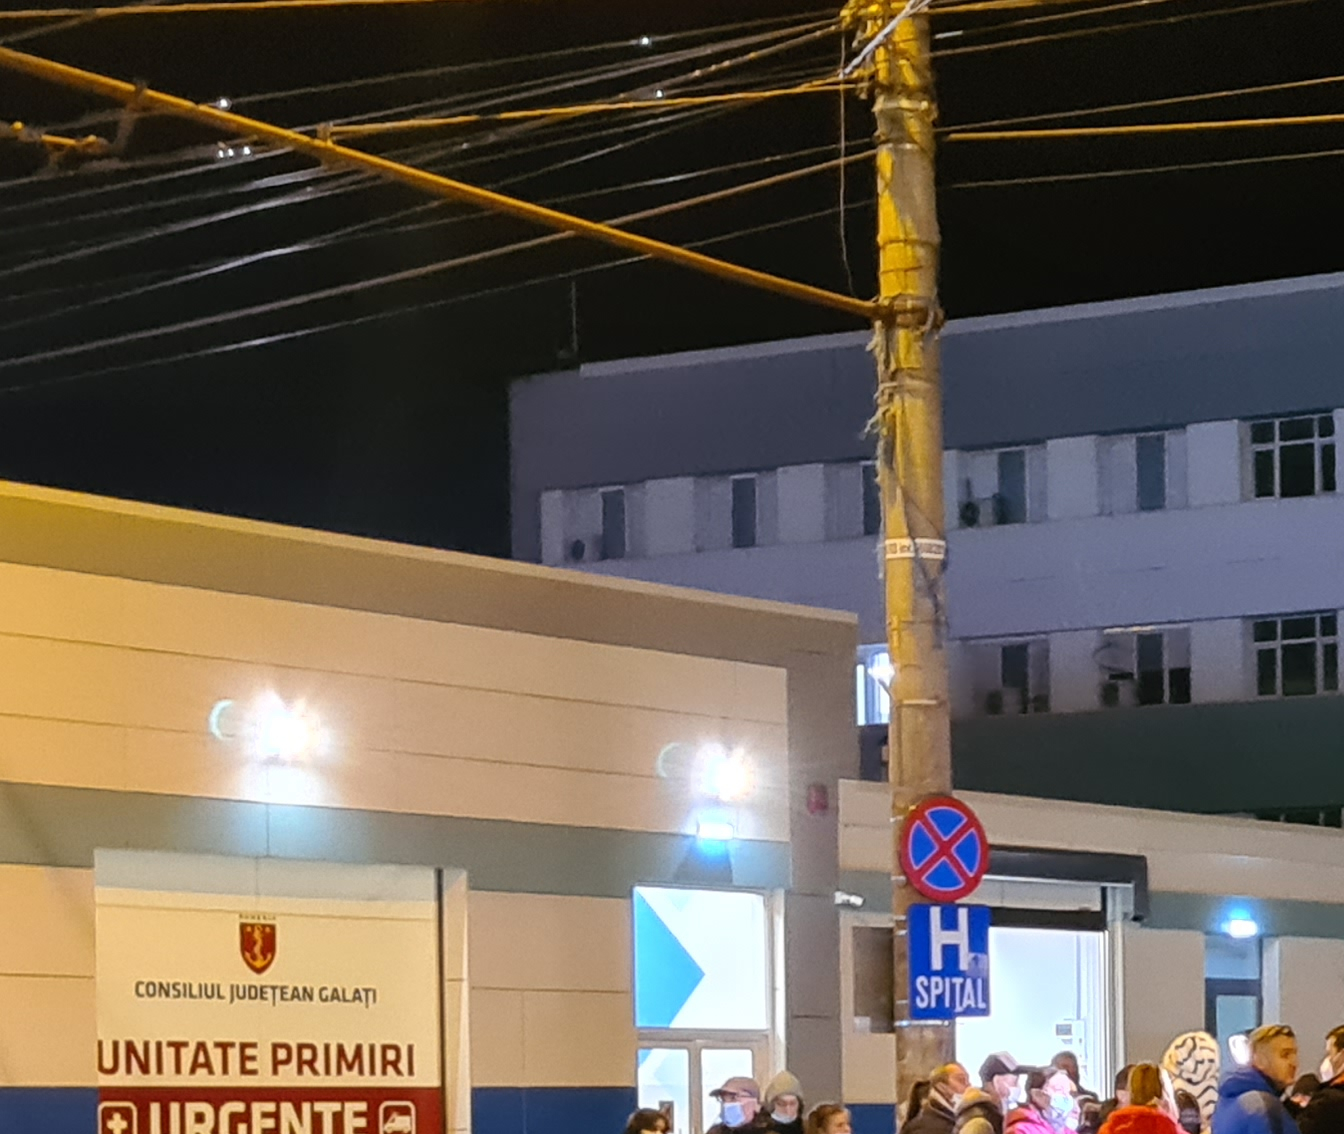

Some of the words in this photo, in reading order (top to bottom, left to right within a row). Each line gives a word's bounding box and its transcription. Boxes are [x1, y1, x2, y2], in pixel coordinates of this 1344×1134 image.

[929, 905, 970, 971] H
[134, 980, 226, 1001] CONSILIUL
[229, 983, 315, 1007] JUDEȚEAN
[318, 986, 377, 1008] GALAȚI
[915, 975, 987, 1013] SPITAL
[97, 1039, 259, 1077] UNITATE
[271, 1042, 416, 1078] PRIMIRI
